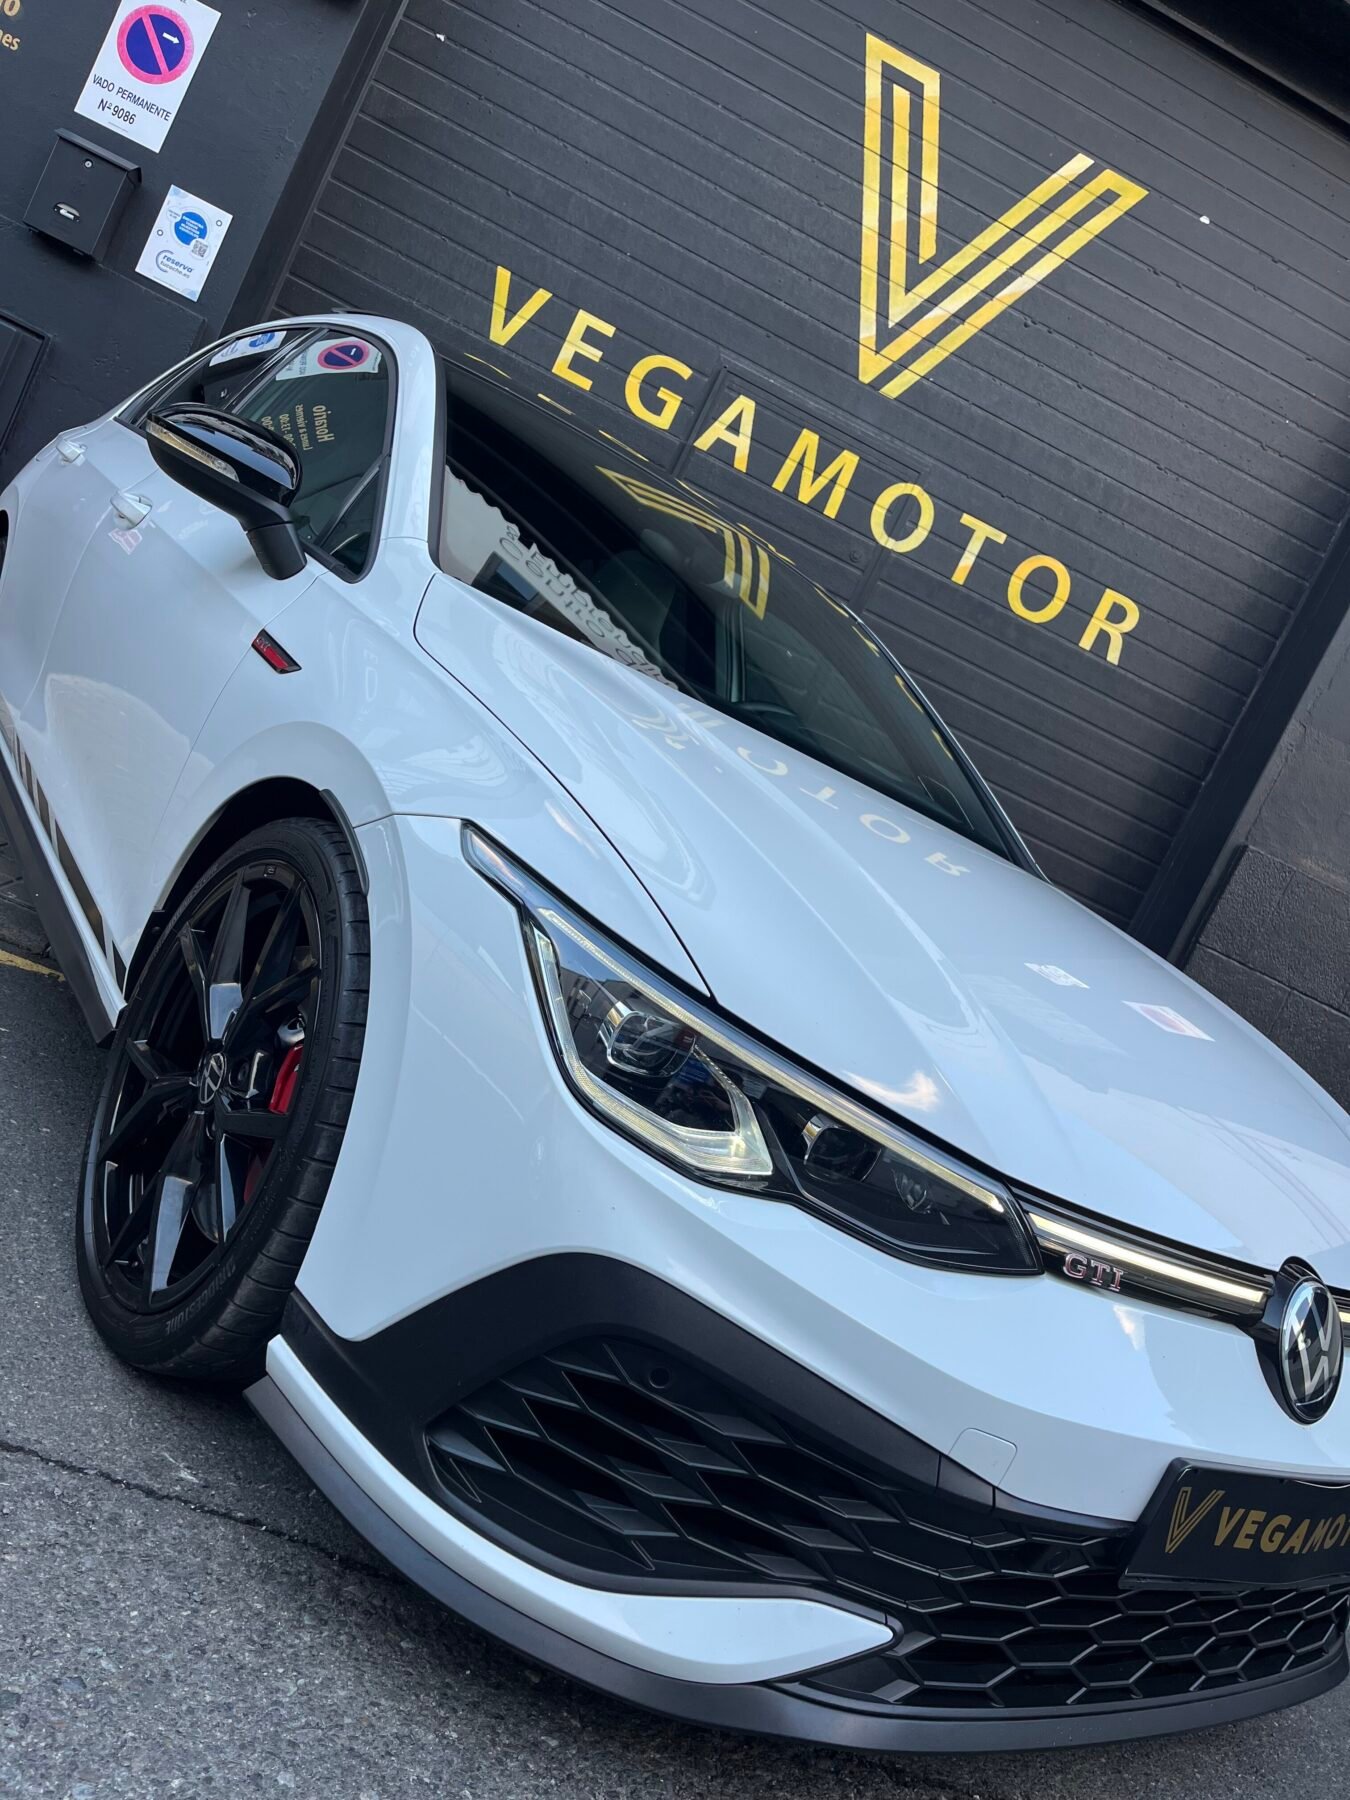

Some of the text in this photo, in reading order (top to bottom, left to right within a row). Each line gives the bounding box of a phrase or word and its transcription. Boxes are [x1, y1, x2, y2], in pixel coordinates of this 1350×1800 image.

[92, 74, 172, 121] VADO PERMANENTE
[162, 254, 194, 273] reserva
[488, 265, 1142, 665] VEGAMOTOR
[1062, 1252, 1125, 1293] GTI
